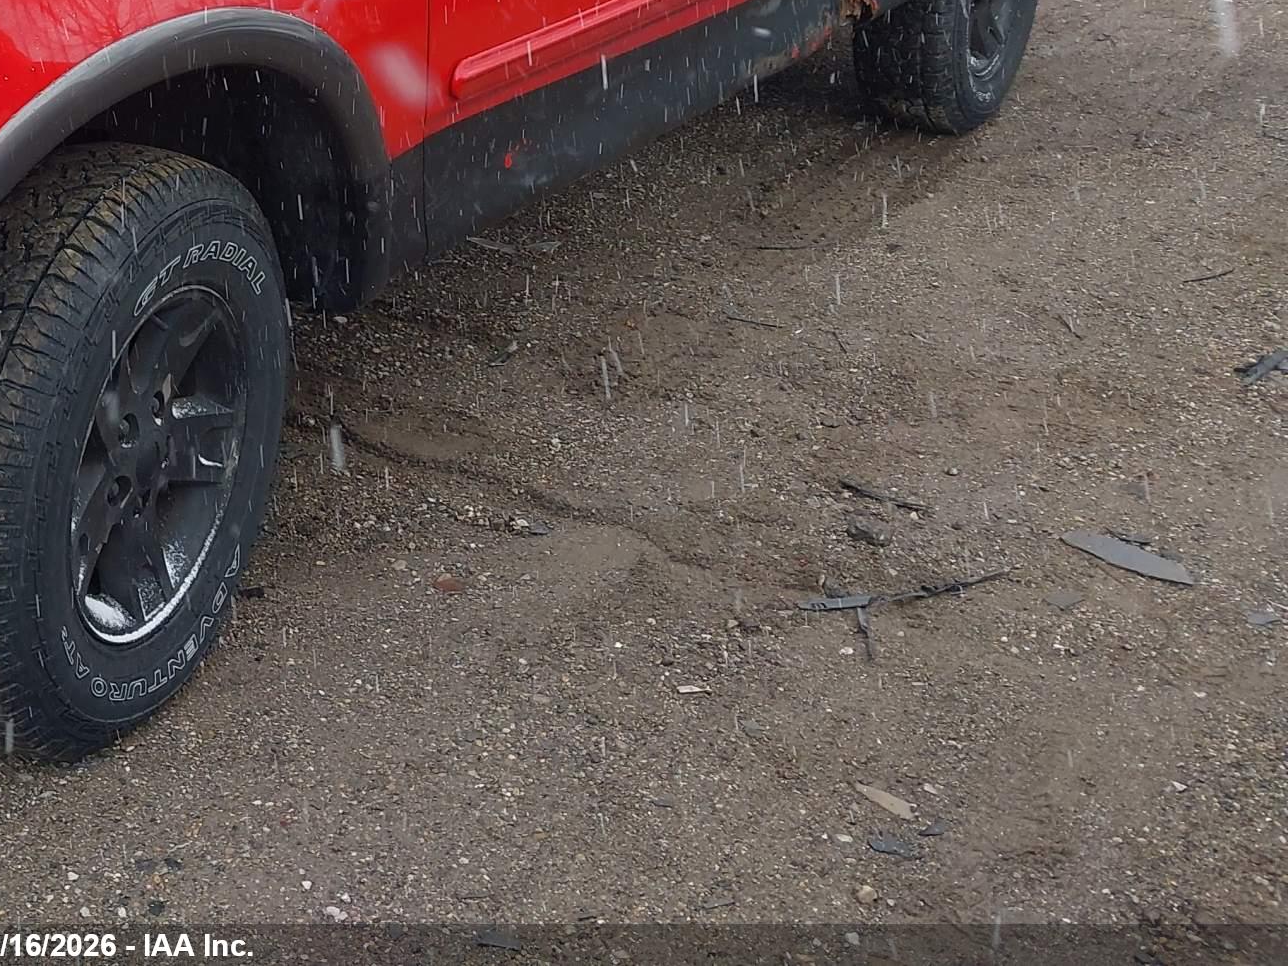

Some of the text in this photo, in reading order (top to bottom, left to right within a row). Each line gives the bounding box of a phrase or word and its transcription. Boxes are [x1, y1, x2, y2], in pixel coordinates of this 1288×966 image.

[134, 240, 266, 317] GT RADIAL
[91, 543, 241, 701] ADVENTURO
